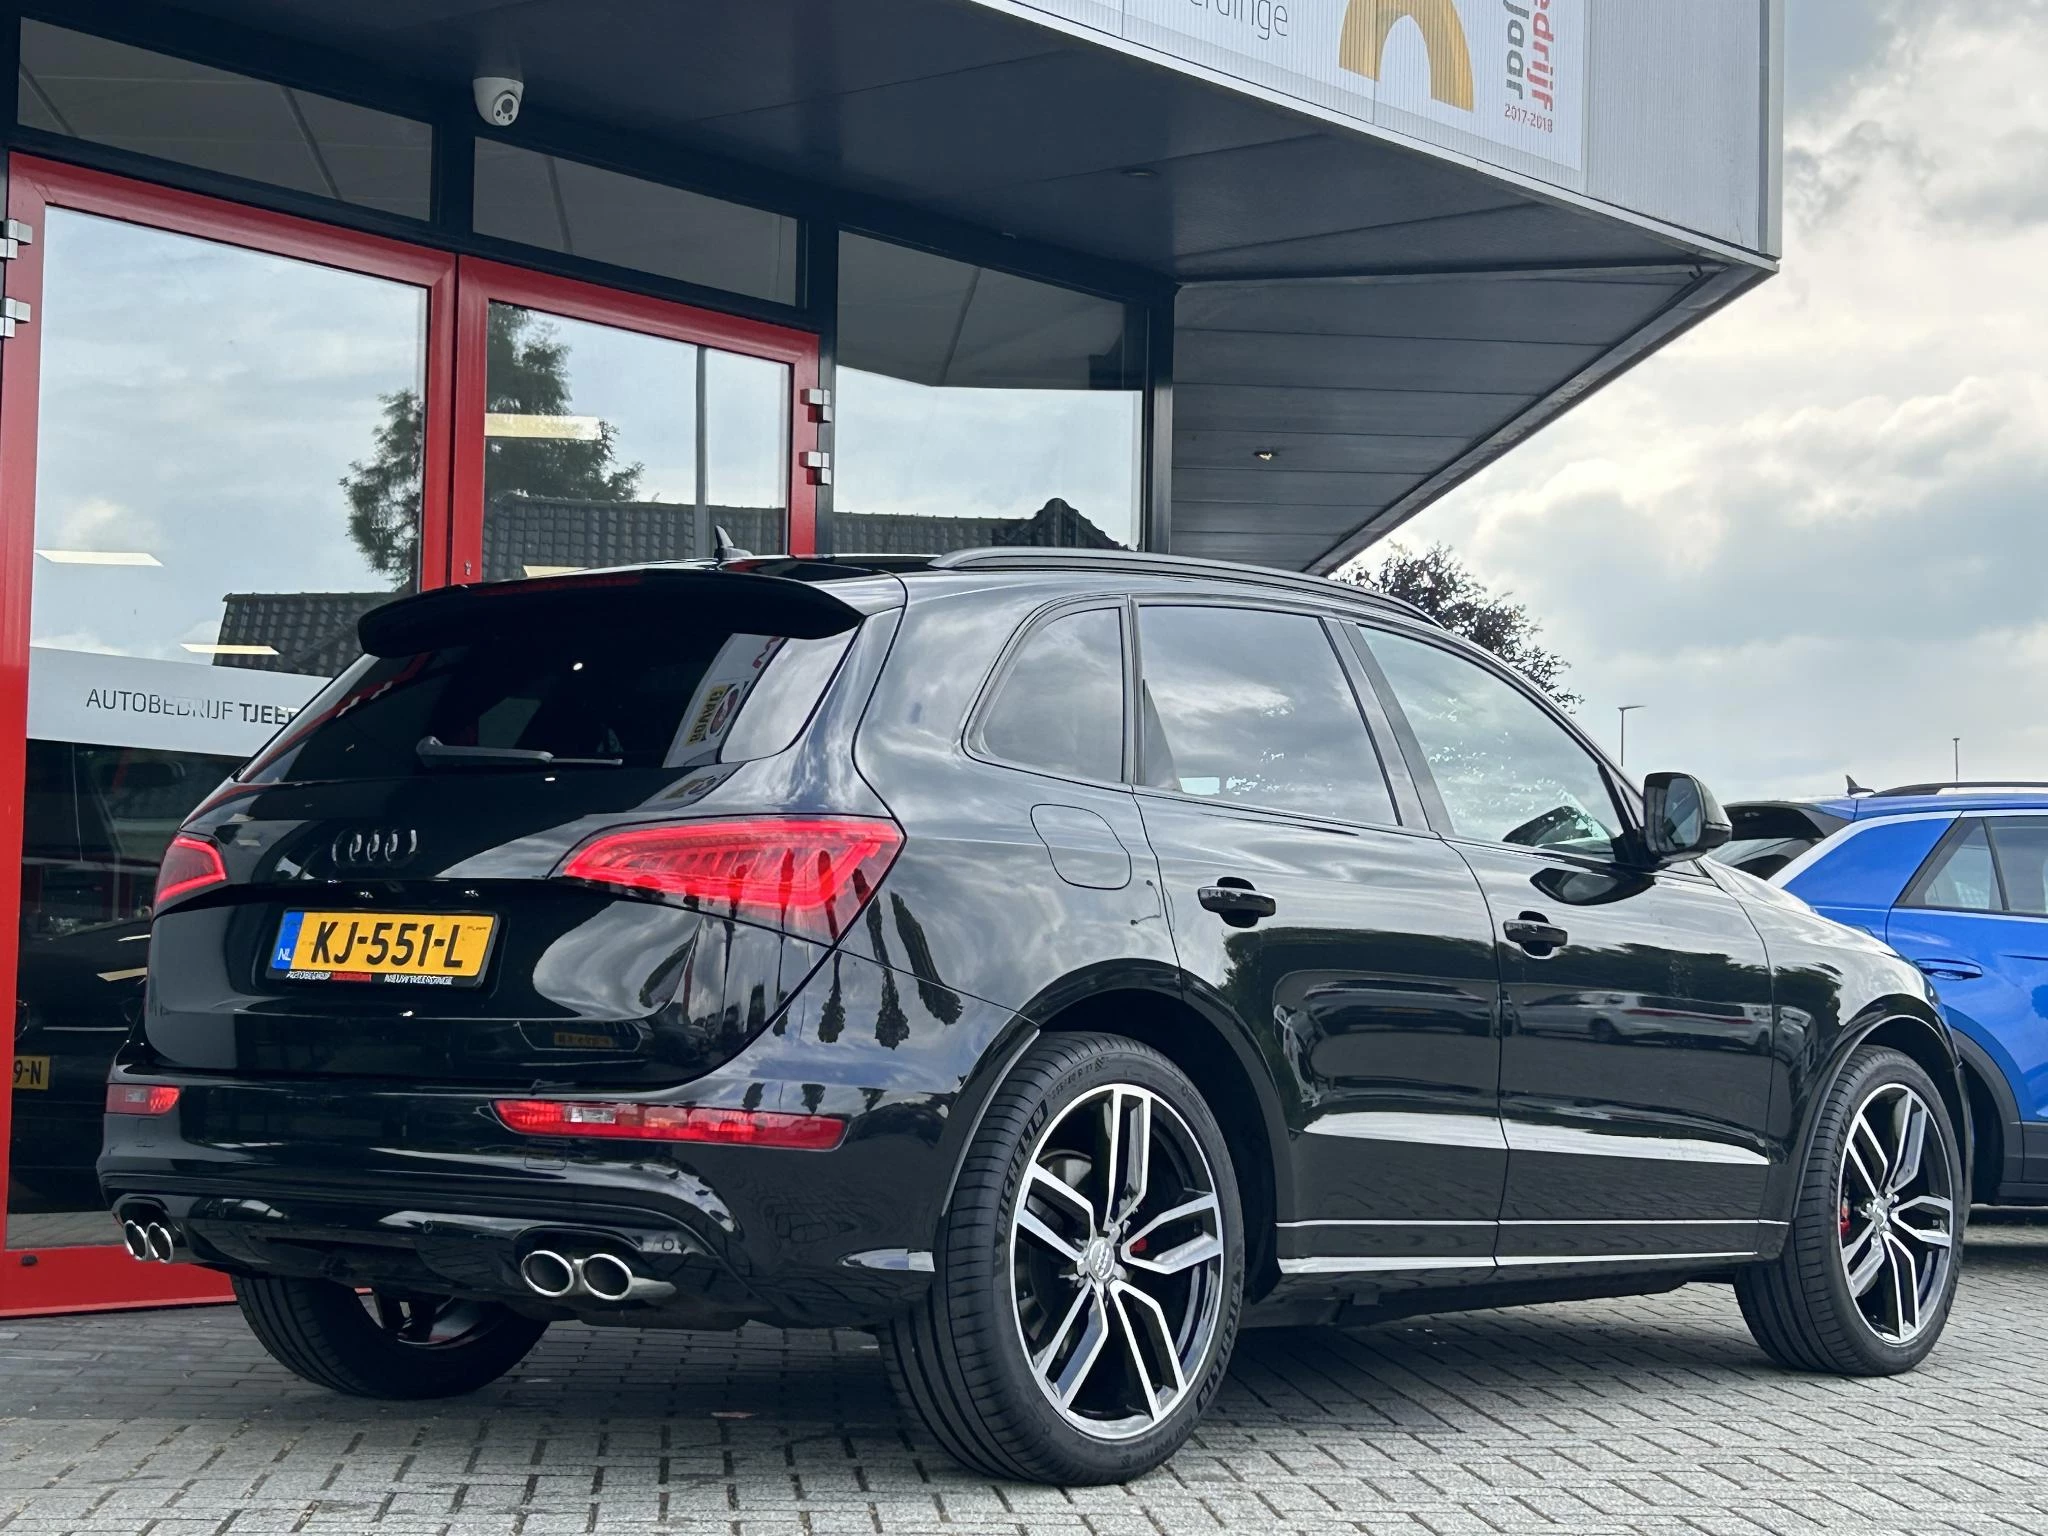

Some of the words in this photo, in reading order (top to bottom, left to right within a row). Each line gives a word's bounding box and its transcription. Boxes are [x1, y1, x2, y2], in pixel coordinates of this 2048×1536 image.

[1504, 103, 1553, 134] 2017-2018
[86, 688, 234, 720] AUTOBEDRIJF
[278, 947, 292, 961] NL
[311, 920, 464, 968] KJ-551-L
